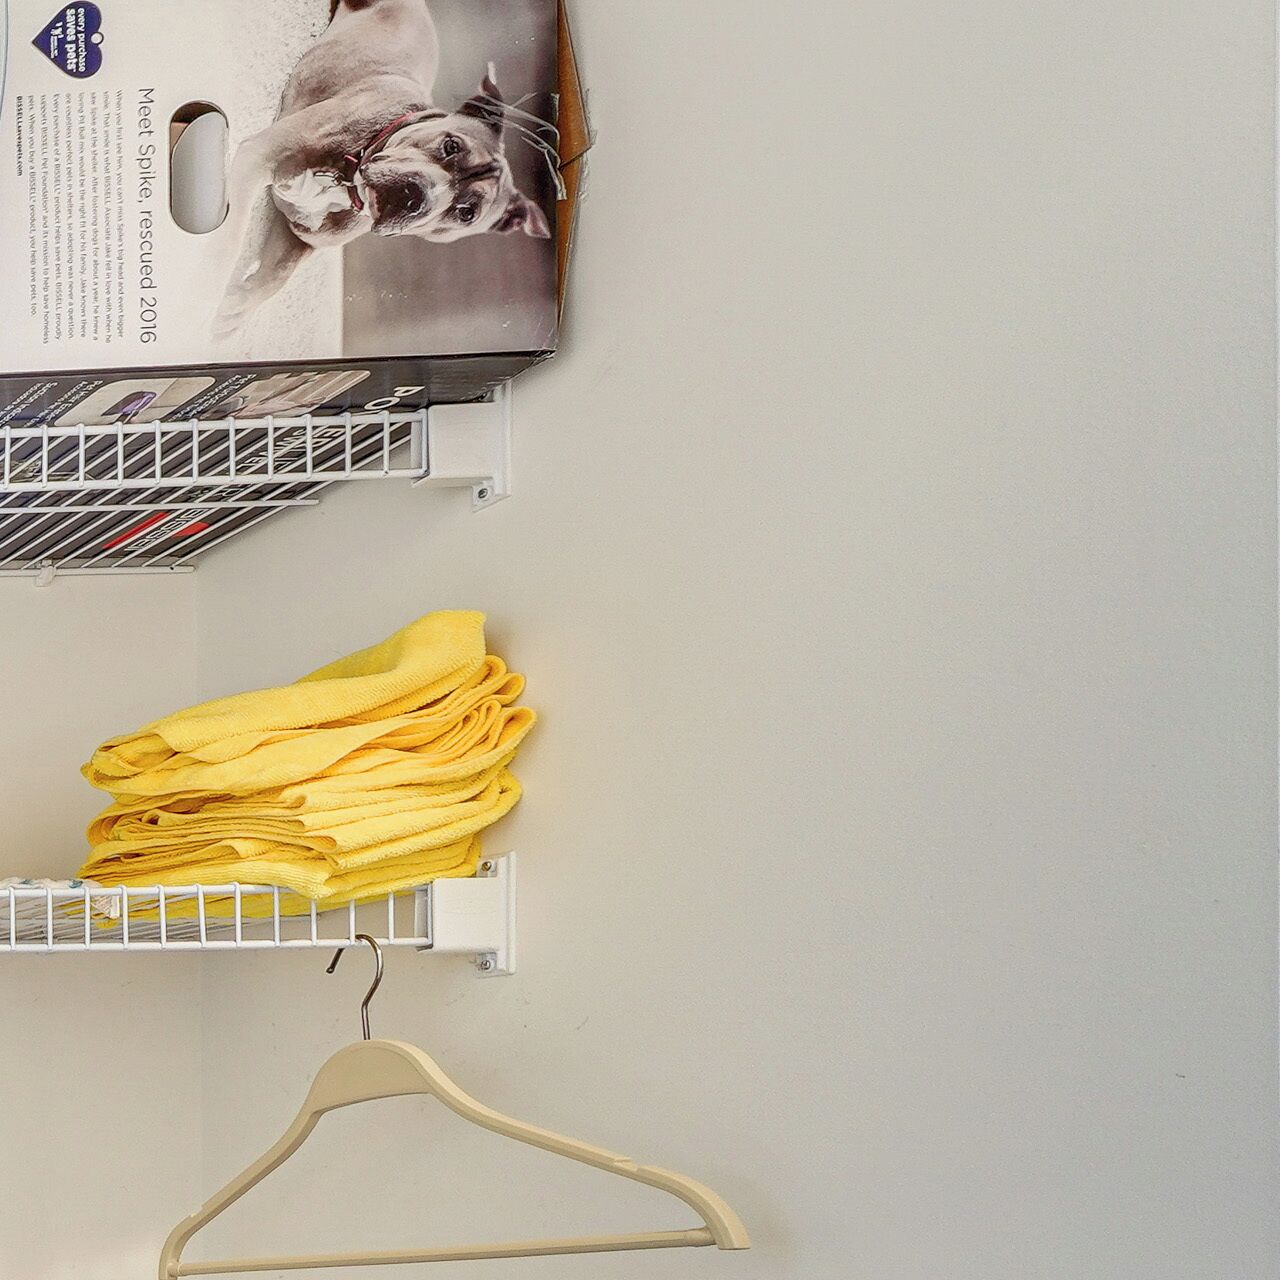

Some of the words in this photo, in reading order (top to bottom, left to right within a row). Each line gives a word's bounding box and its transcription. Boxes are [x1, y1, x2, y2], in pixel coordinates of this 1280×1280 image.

[66, 9, 76, 41] saves
[77, 8, 85, 31] every
[78, 34, 86, 72] purchase
[138, 88, 155, 136] Meet
[15, 96, 23, 176] BISSELLsavespets.com
[136, 144, 156, 204] Spike,
[140, 210, 157, 289] rescued
[140, 297, 157, 343] 2016
